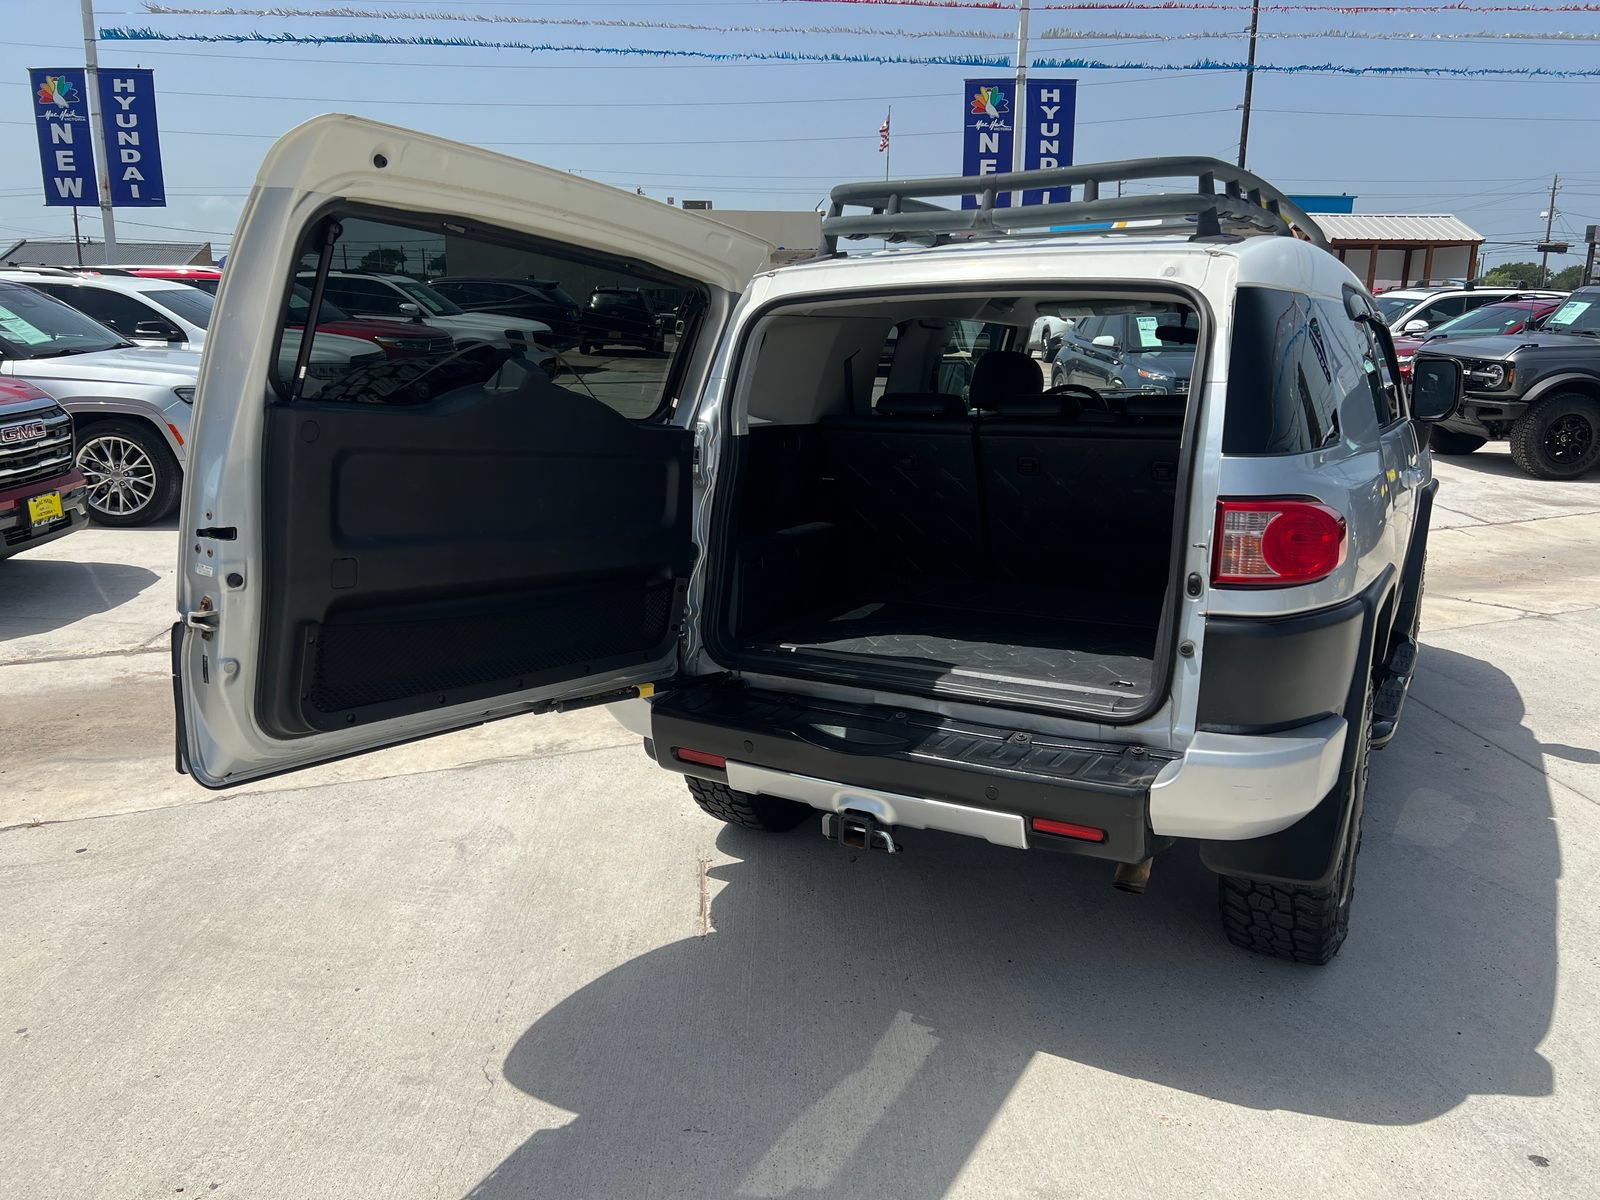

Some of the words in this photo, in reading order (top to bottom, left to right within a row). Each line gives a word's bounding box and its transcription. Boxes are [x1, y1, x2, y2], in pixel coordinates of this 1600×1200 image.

[50, 123, 83, 198] NEW
[113, 78, 145, 199] HYUNDAI
[1040, 89, 1061, 205] HYUNDI
[1, 422, 46, 442] GMC
